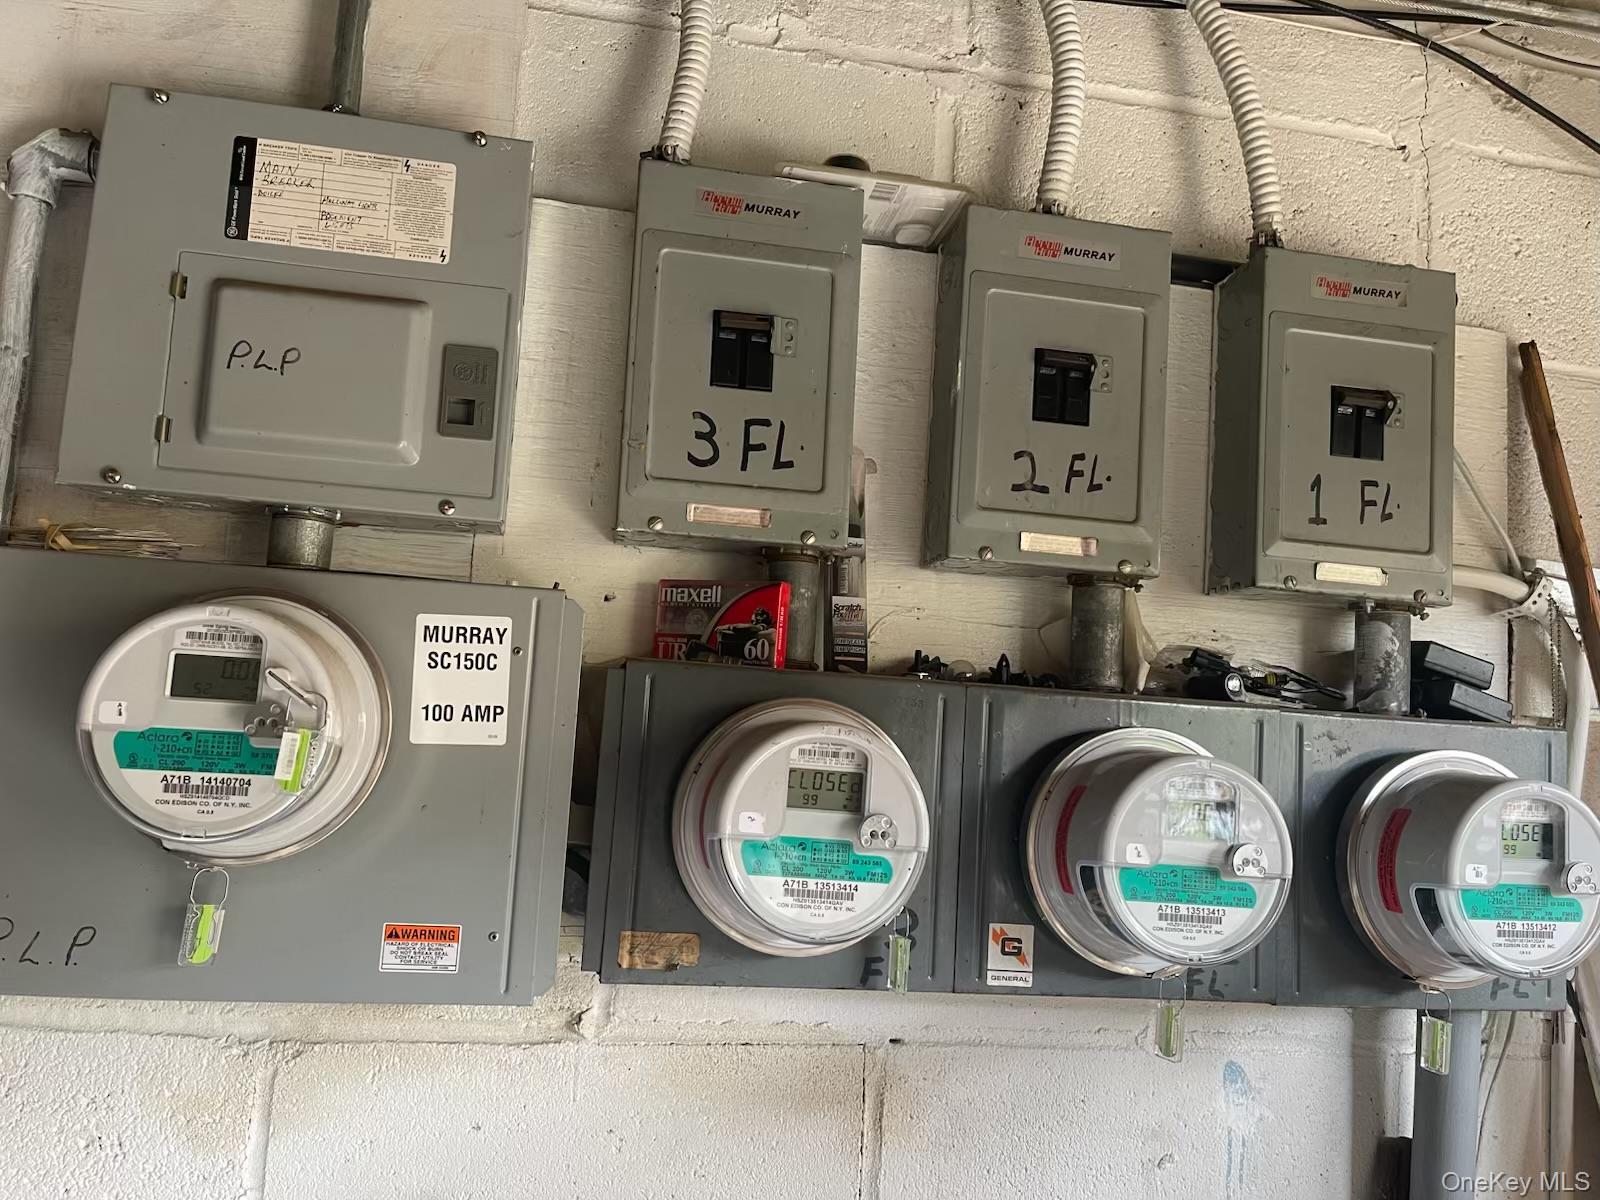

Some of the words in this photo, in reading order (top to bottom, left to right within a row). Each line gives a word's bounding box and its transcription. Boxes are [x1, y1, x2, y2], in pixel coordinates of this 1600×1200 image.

[258, 160, 300, 177] MAIN
[743, 203, 801, 219] MURRAY
[1063, 246, 1116, 262] MURRAY
[1352, 286, 1402, 300] MURRAY
[687, 411, 720, 468] 3
[1010, 450, 1050, 494] 2
[1064, 452, 1112, 494] FL.
[1308, 473, 1328, 526] 1
[661, 585, 722, 603] maxell
[423, 625, 508, 645] MURRAY
[658, 642, 686, 661] UR
[744, 638, 770, 661] 60
[427, 652, 498, 671] SC150C
[422, 704, 454, 722] 100
[461, 704, 504, 723] AMP
[137, 732, 180, 742] Aclara
[160, 774, 192, 784] A71B
[200, 776, 252, 786] 14140704
[803, 793, 818, 806] 99
[1503, 844, 1517, 855] 99
[782, 880, 808, 889] A71B
[814, 881, 858, 892] 13513414
[1158, 904, 1181, 914] A71B
[1186, 906, 1226, 917] 13513413
[400, 928, 456, 941] WARNING
[1496, 922, 1516, 930] A71B
[1521, 922, 1557, 932] 13513412
[1000, 936, 1022, 956] G
